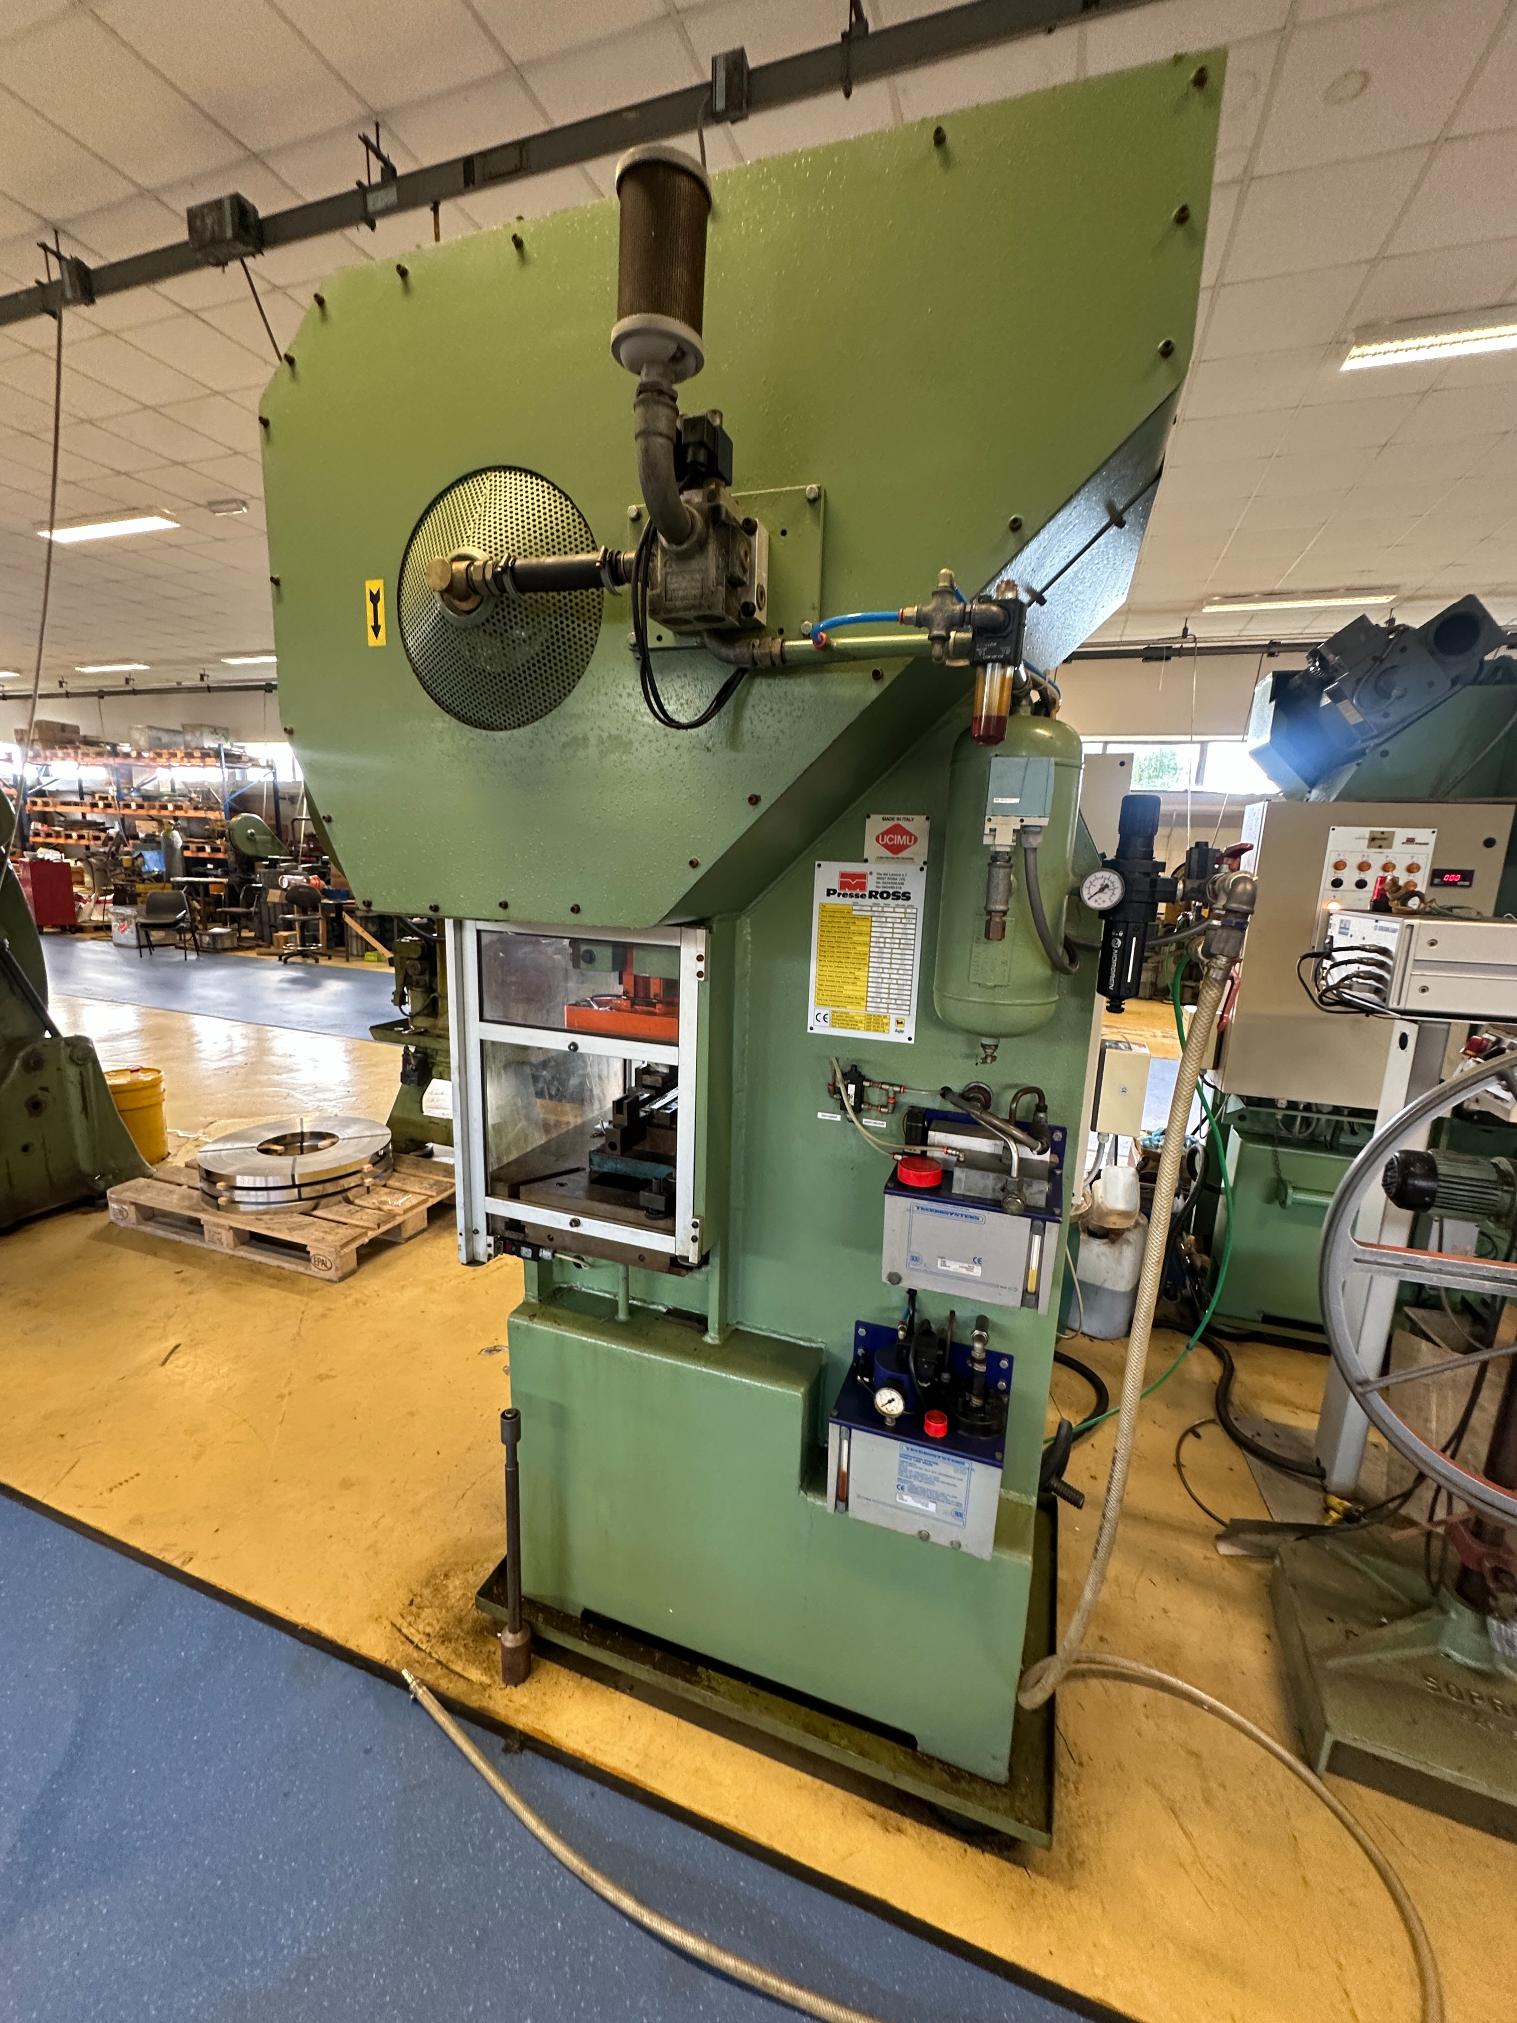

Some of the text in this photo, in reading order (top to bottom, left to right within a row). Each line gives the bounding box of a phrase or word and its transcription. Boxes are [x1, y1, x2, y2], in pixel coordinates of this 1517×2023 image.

[878, 834, 915, 846] UCIMU
[826, 888, 911, 902] Presse ROSS
[1108, 949, 1119, 991] NORGREN
[815, 1012, 829, 1023] CE
[313, 1256, 329, 1269] EPAL
[972, 1256, 983, 1265] CE
[1423, 1672, 1517, 1718] SOPR
